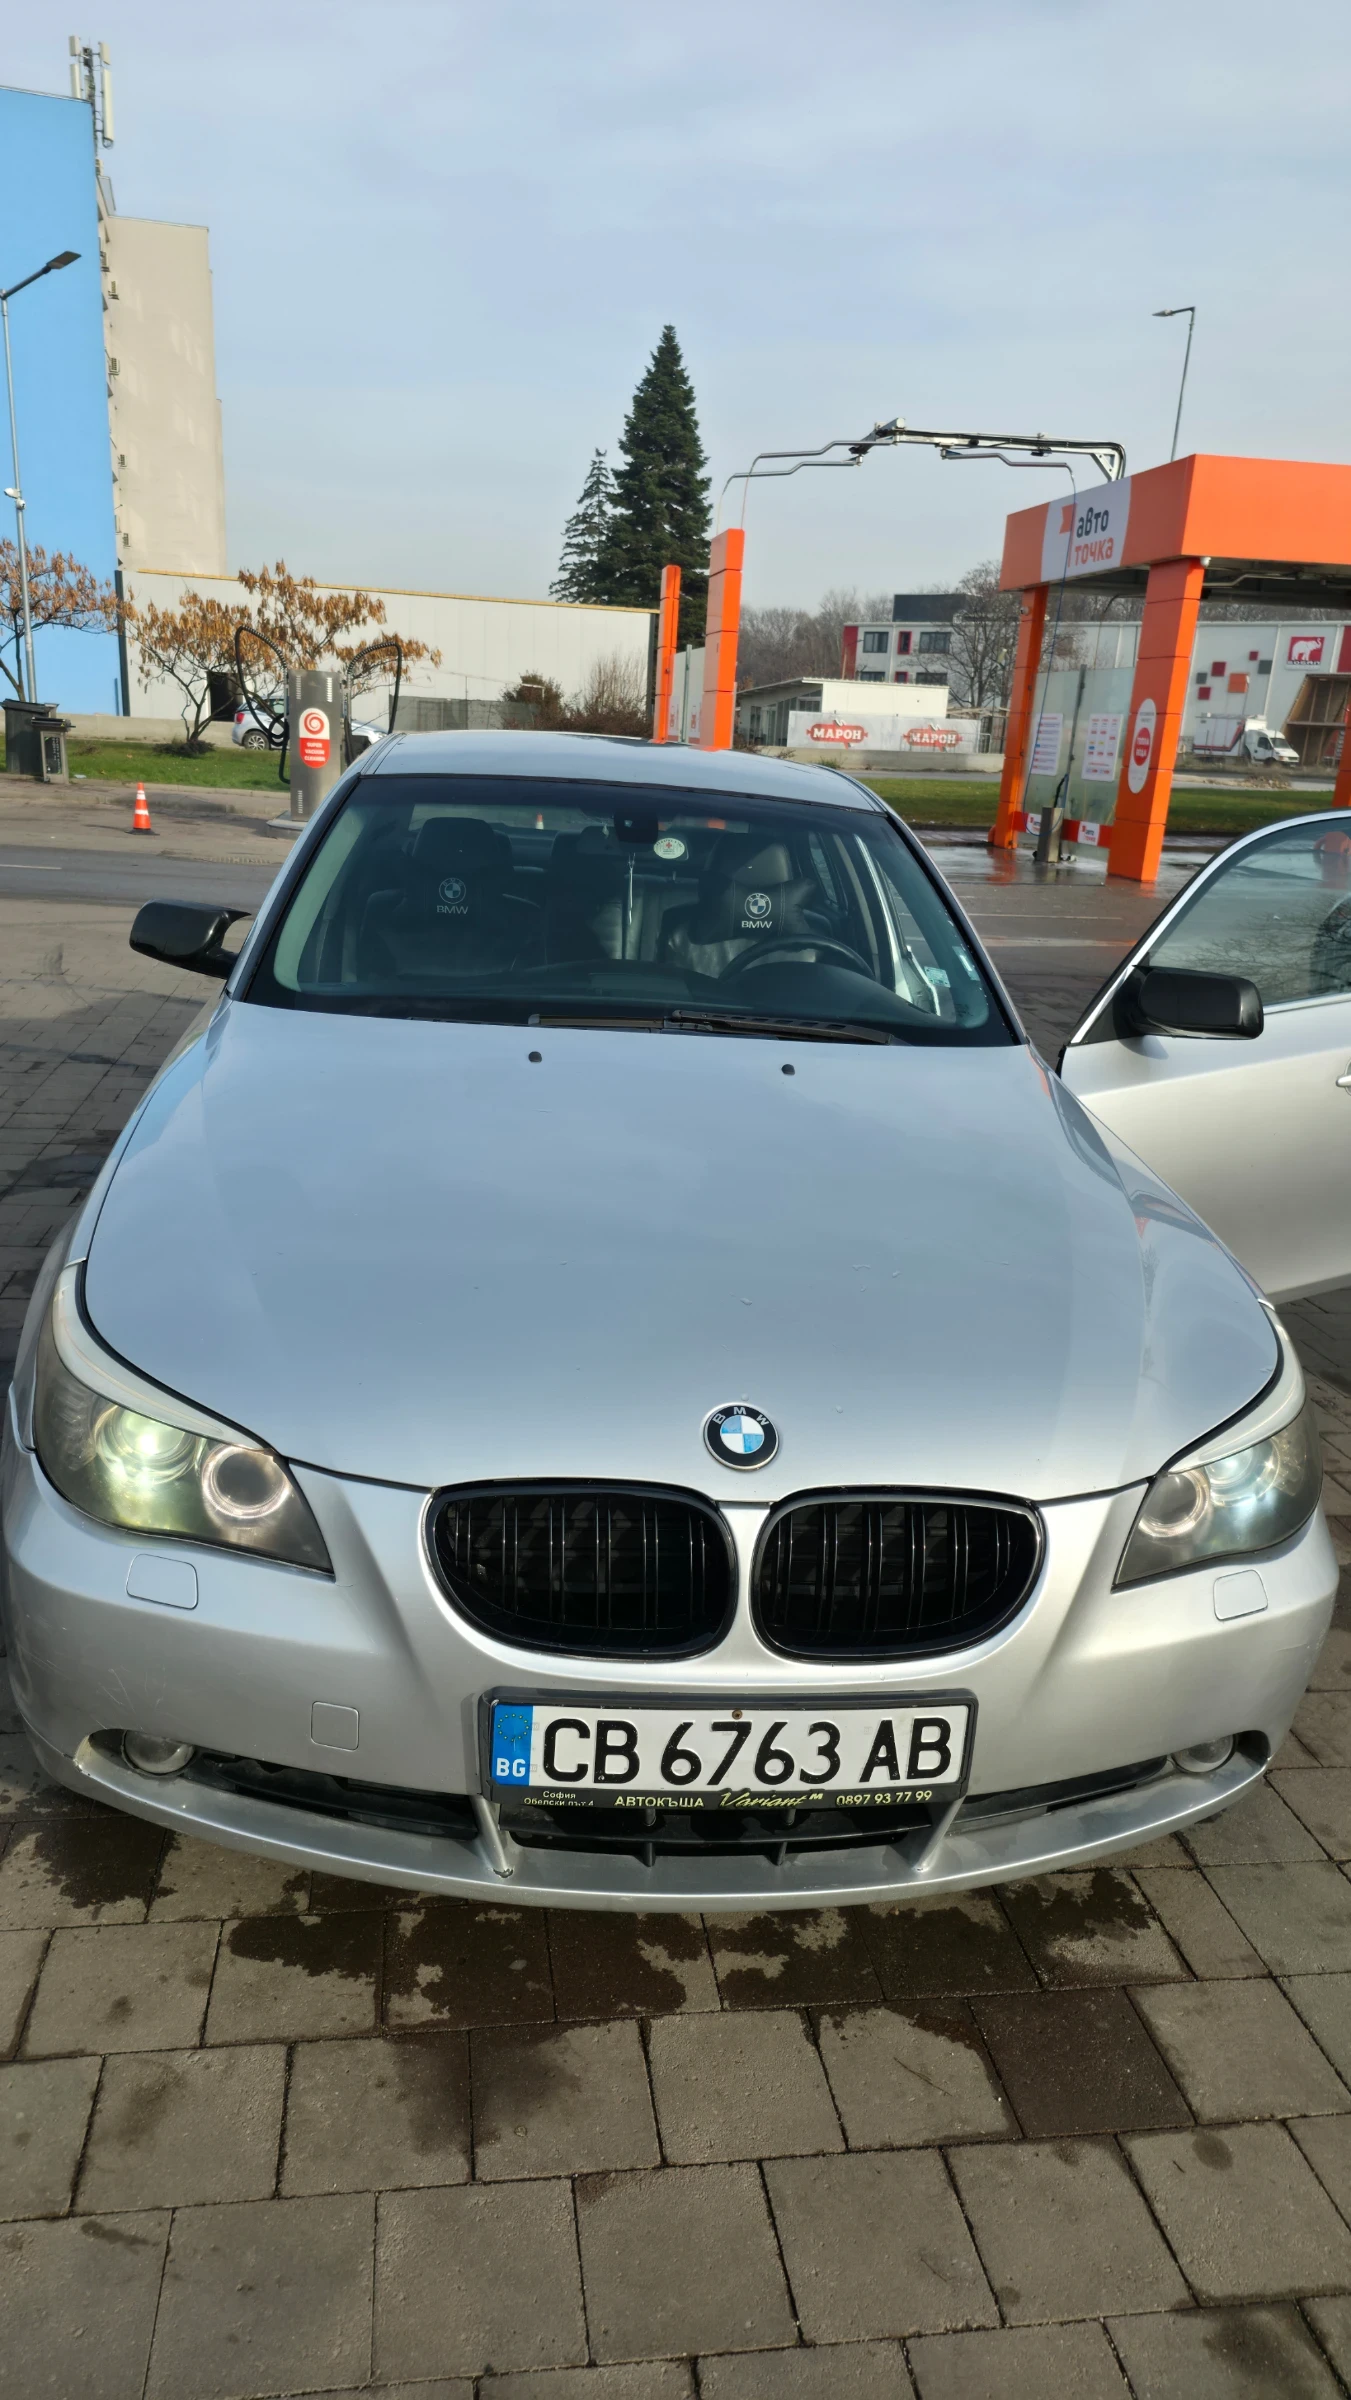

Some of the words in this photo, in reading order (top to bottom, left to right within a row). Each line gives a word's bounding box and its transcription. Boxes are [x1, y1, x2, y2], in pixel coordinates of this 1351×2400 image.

[1076, 507, 1109, 538] авто
[1075, 537, 1114, 566] точка
[813, 728, 862, 740] МАРОН
[909, 733, 957, 744] МАРОН
[436, 905, 469, 914] BMW
[741, 920, 773, 929] BMW
[712, 1406, 769, 1426] BMW
[543, 1718, 640, 1784] CB
[660, 1721, 841, 1786] 6763
[858, 1716, 951, 1784] AB
[496, 1757, 527, 1778] BG
[523, 1797, 565, 1806] Обелски
[542, 1790, 576, 1800] София
[719, 1792, 807, 1807] Variant
[836, 1794, 870, 1807] 0897
[874, 1794, 891, 1804] 93
[895, 1792, 912, 1803] 77
[915, 1790, 933, 1801] 99
